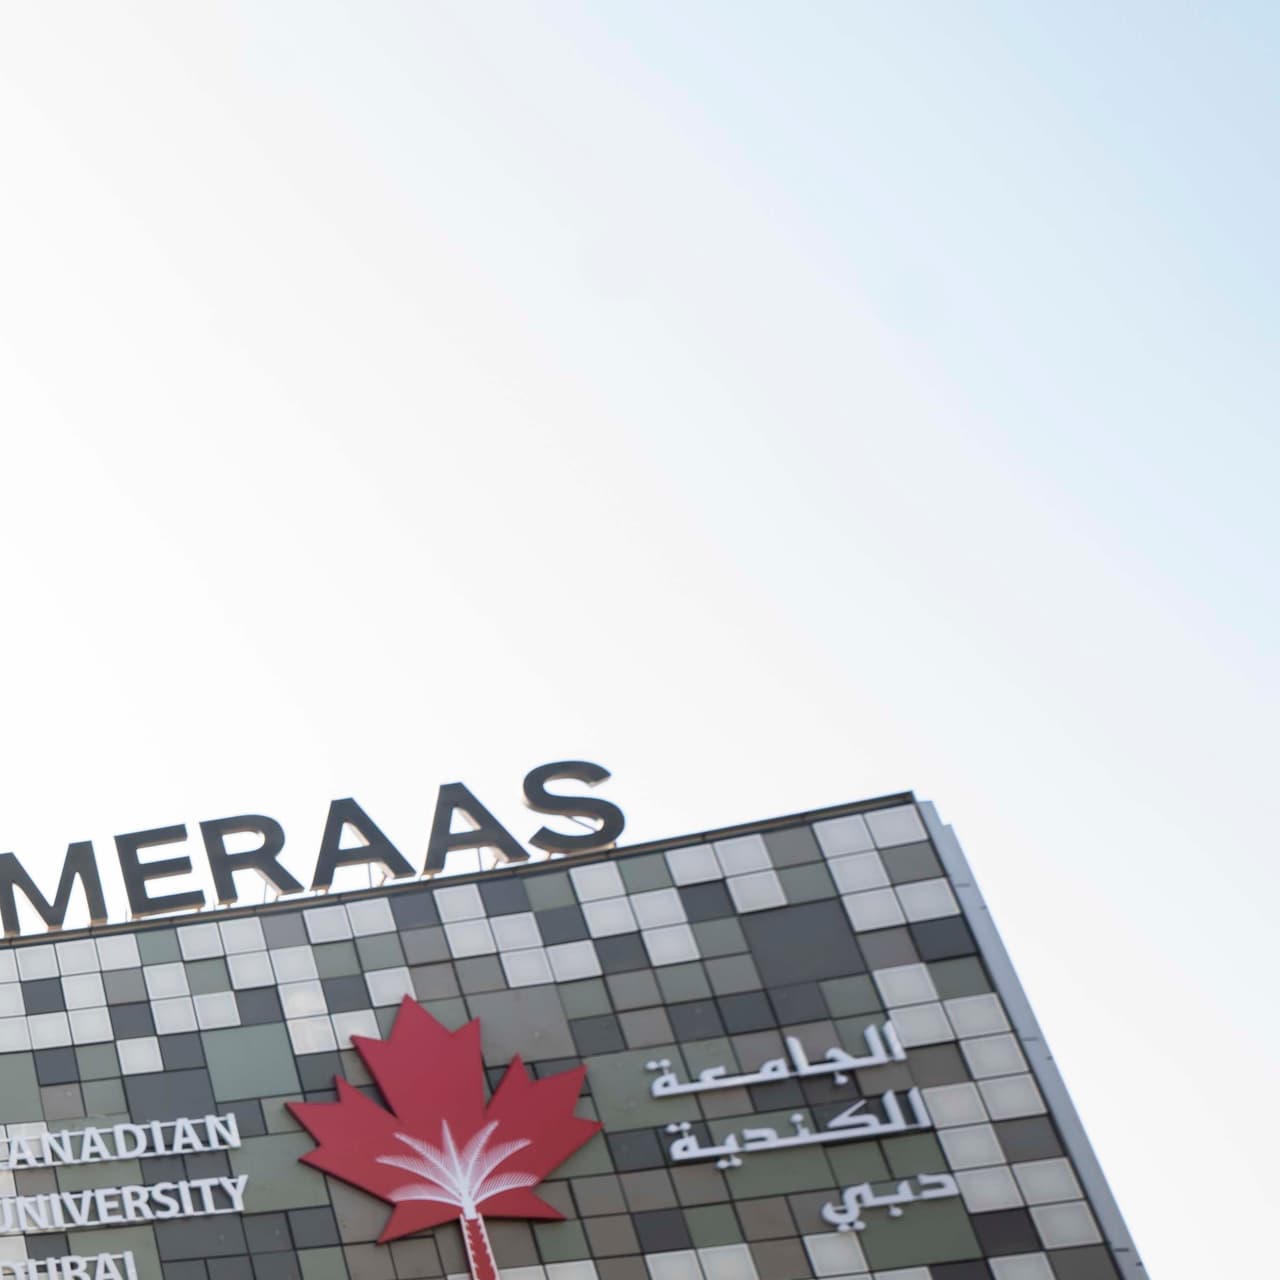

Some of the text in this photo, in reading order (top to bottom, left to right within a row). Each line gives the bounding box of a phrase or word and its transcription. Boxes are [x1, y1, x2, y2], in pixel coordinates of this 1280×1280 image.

[646, 1020, 908, 1098] الجامعة
[666, 1086, 934, 1170] الكندية
[821, 1173, 960, 1232] دبي
